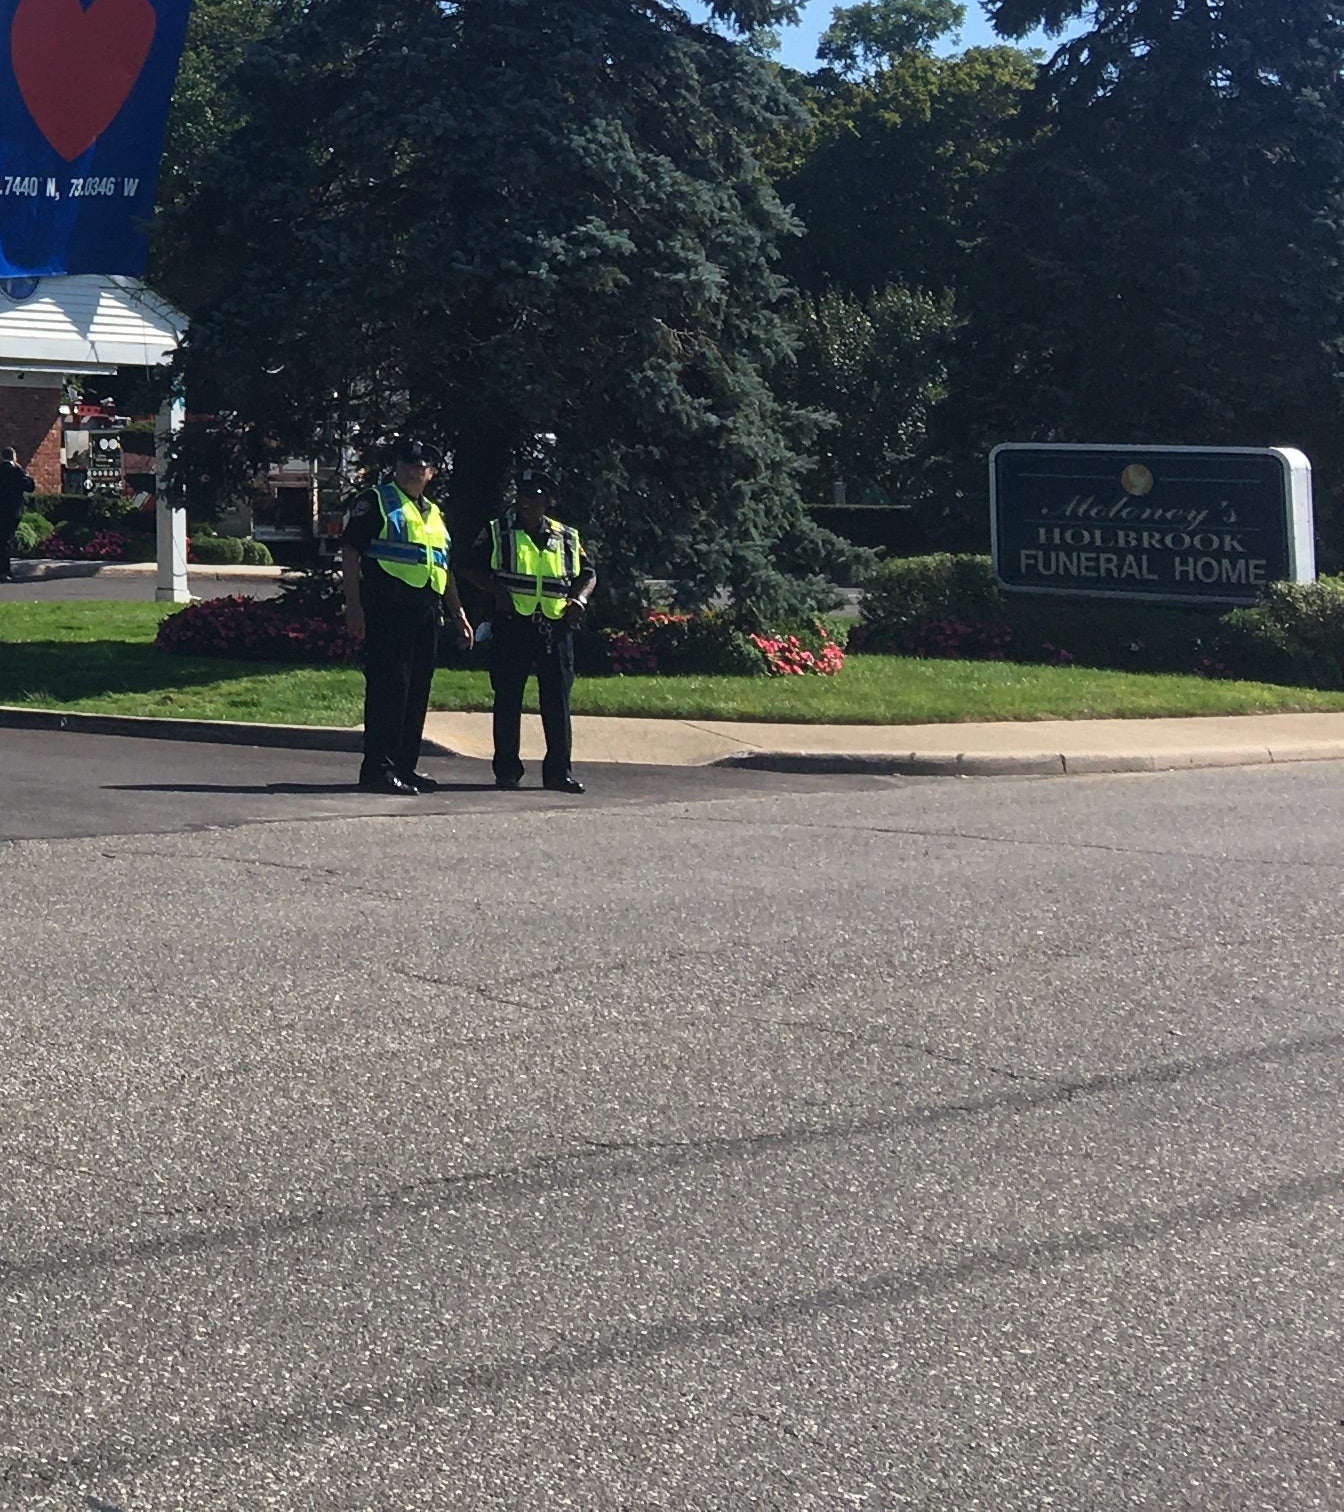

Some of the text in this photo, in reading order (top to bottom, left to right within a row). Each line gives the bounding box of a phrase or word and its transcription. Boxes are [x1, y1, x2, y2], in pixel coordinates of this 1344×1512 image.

[123, 177, 140, 197] W
[1037, 526, 1248, 553] HOLBROOK
[1019, 549, 1268, 586] FUNERAL HOME
